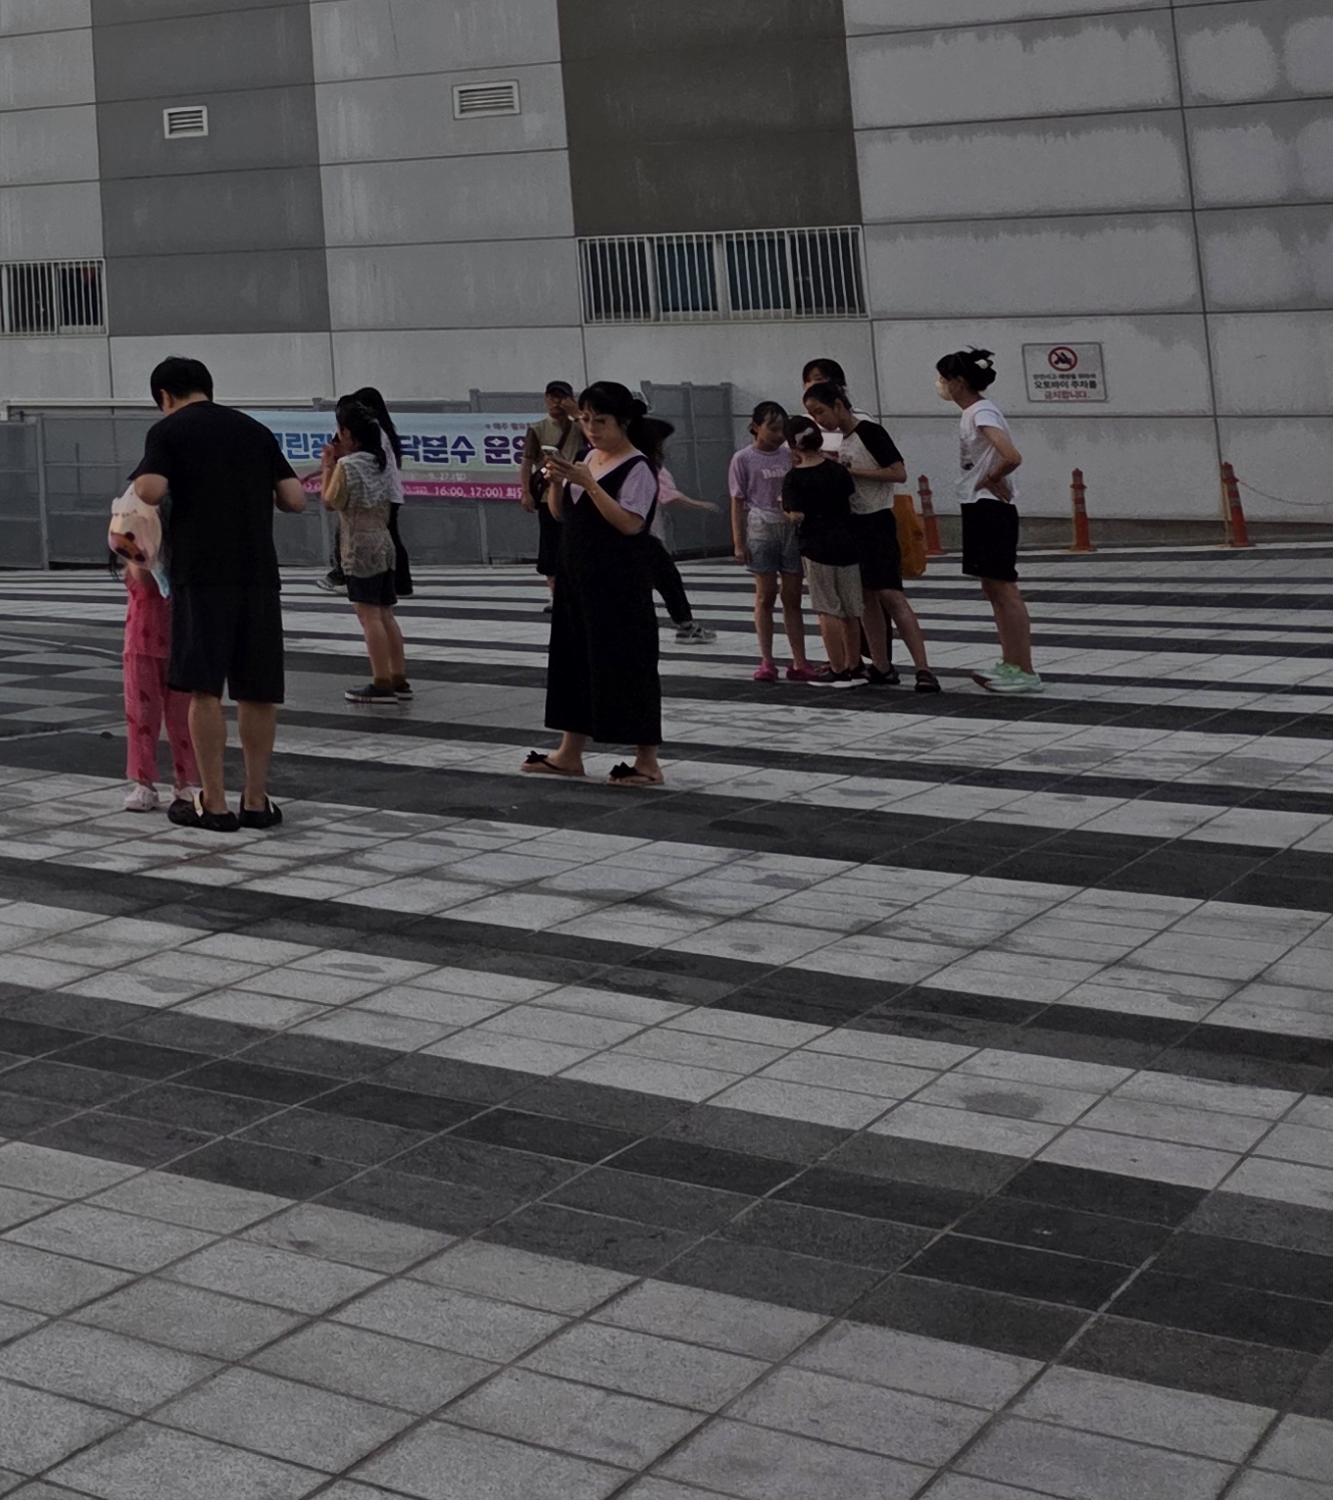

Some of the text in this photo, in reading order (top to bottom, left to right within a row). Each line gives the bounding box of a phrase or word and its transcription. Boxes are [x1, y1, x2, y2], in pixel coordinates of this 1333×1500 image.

[1034, 380, 1097, 389] 오토바이 주차를
[398, 435, 476, 464] 닥분수
[470, 486, 504, 499] 17:00)
